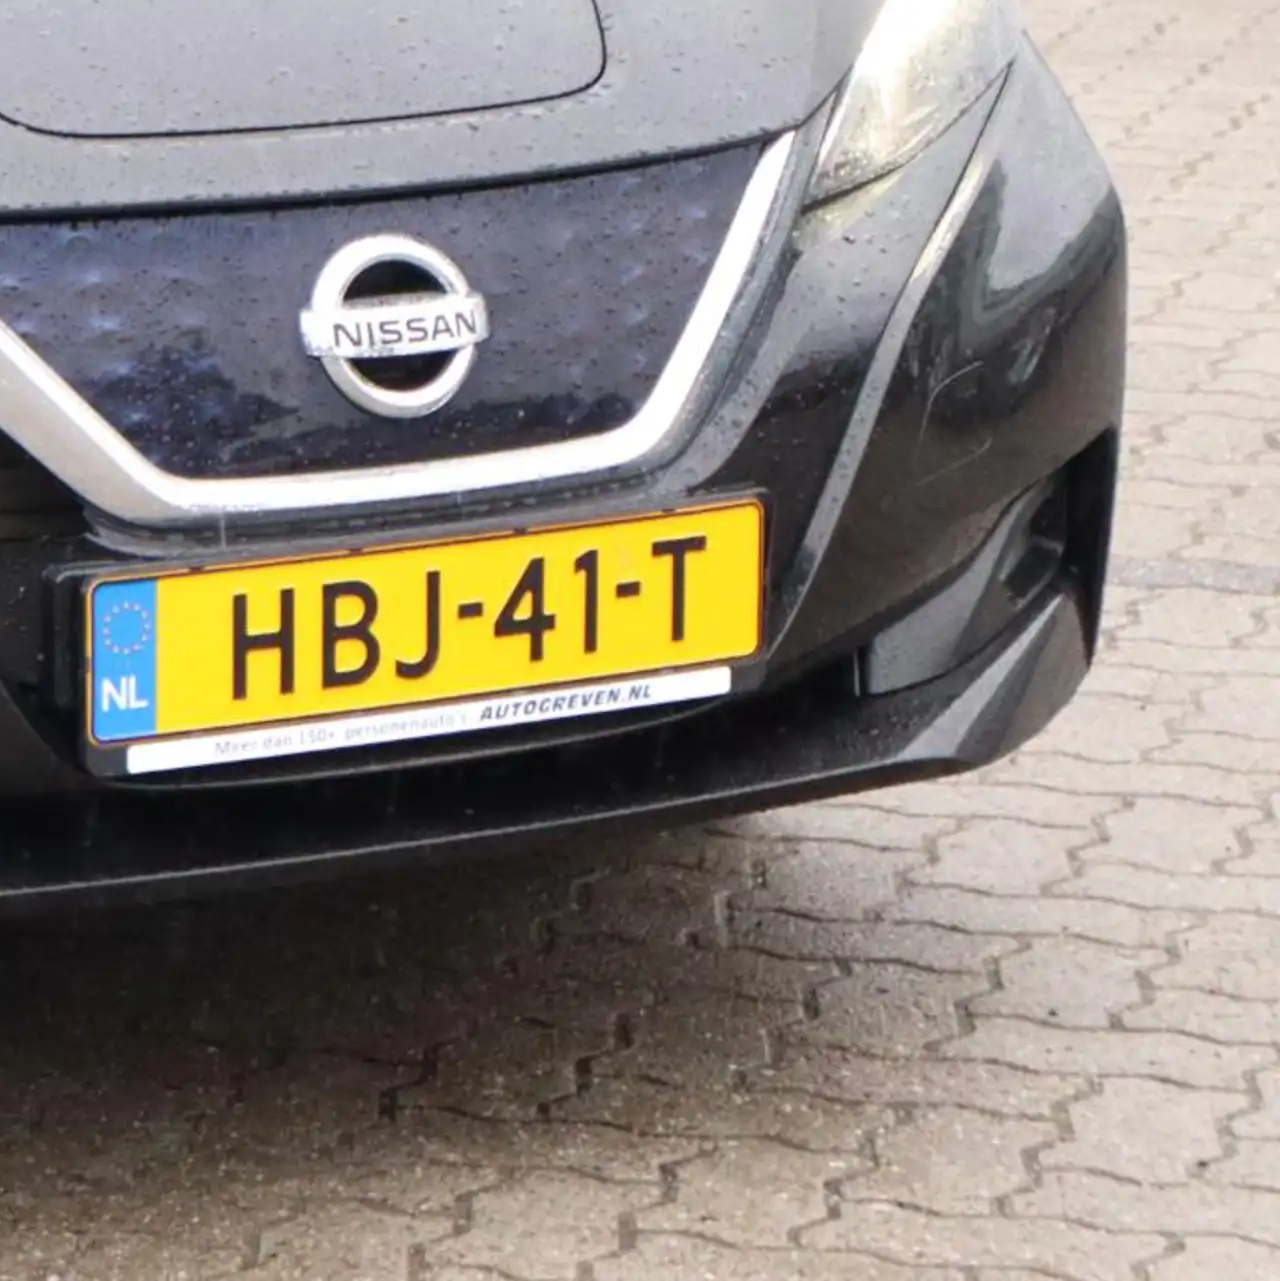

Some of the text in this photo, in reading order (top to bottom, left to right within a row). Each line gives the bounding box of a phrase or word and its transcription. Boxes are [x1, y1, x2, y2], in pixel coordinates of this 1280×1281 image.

[333, 310, 477, 349] NISSAN
[232, 536, 707, 700] HBJ-41-T
[102, 674, 149, 713] NL
